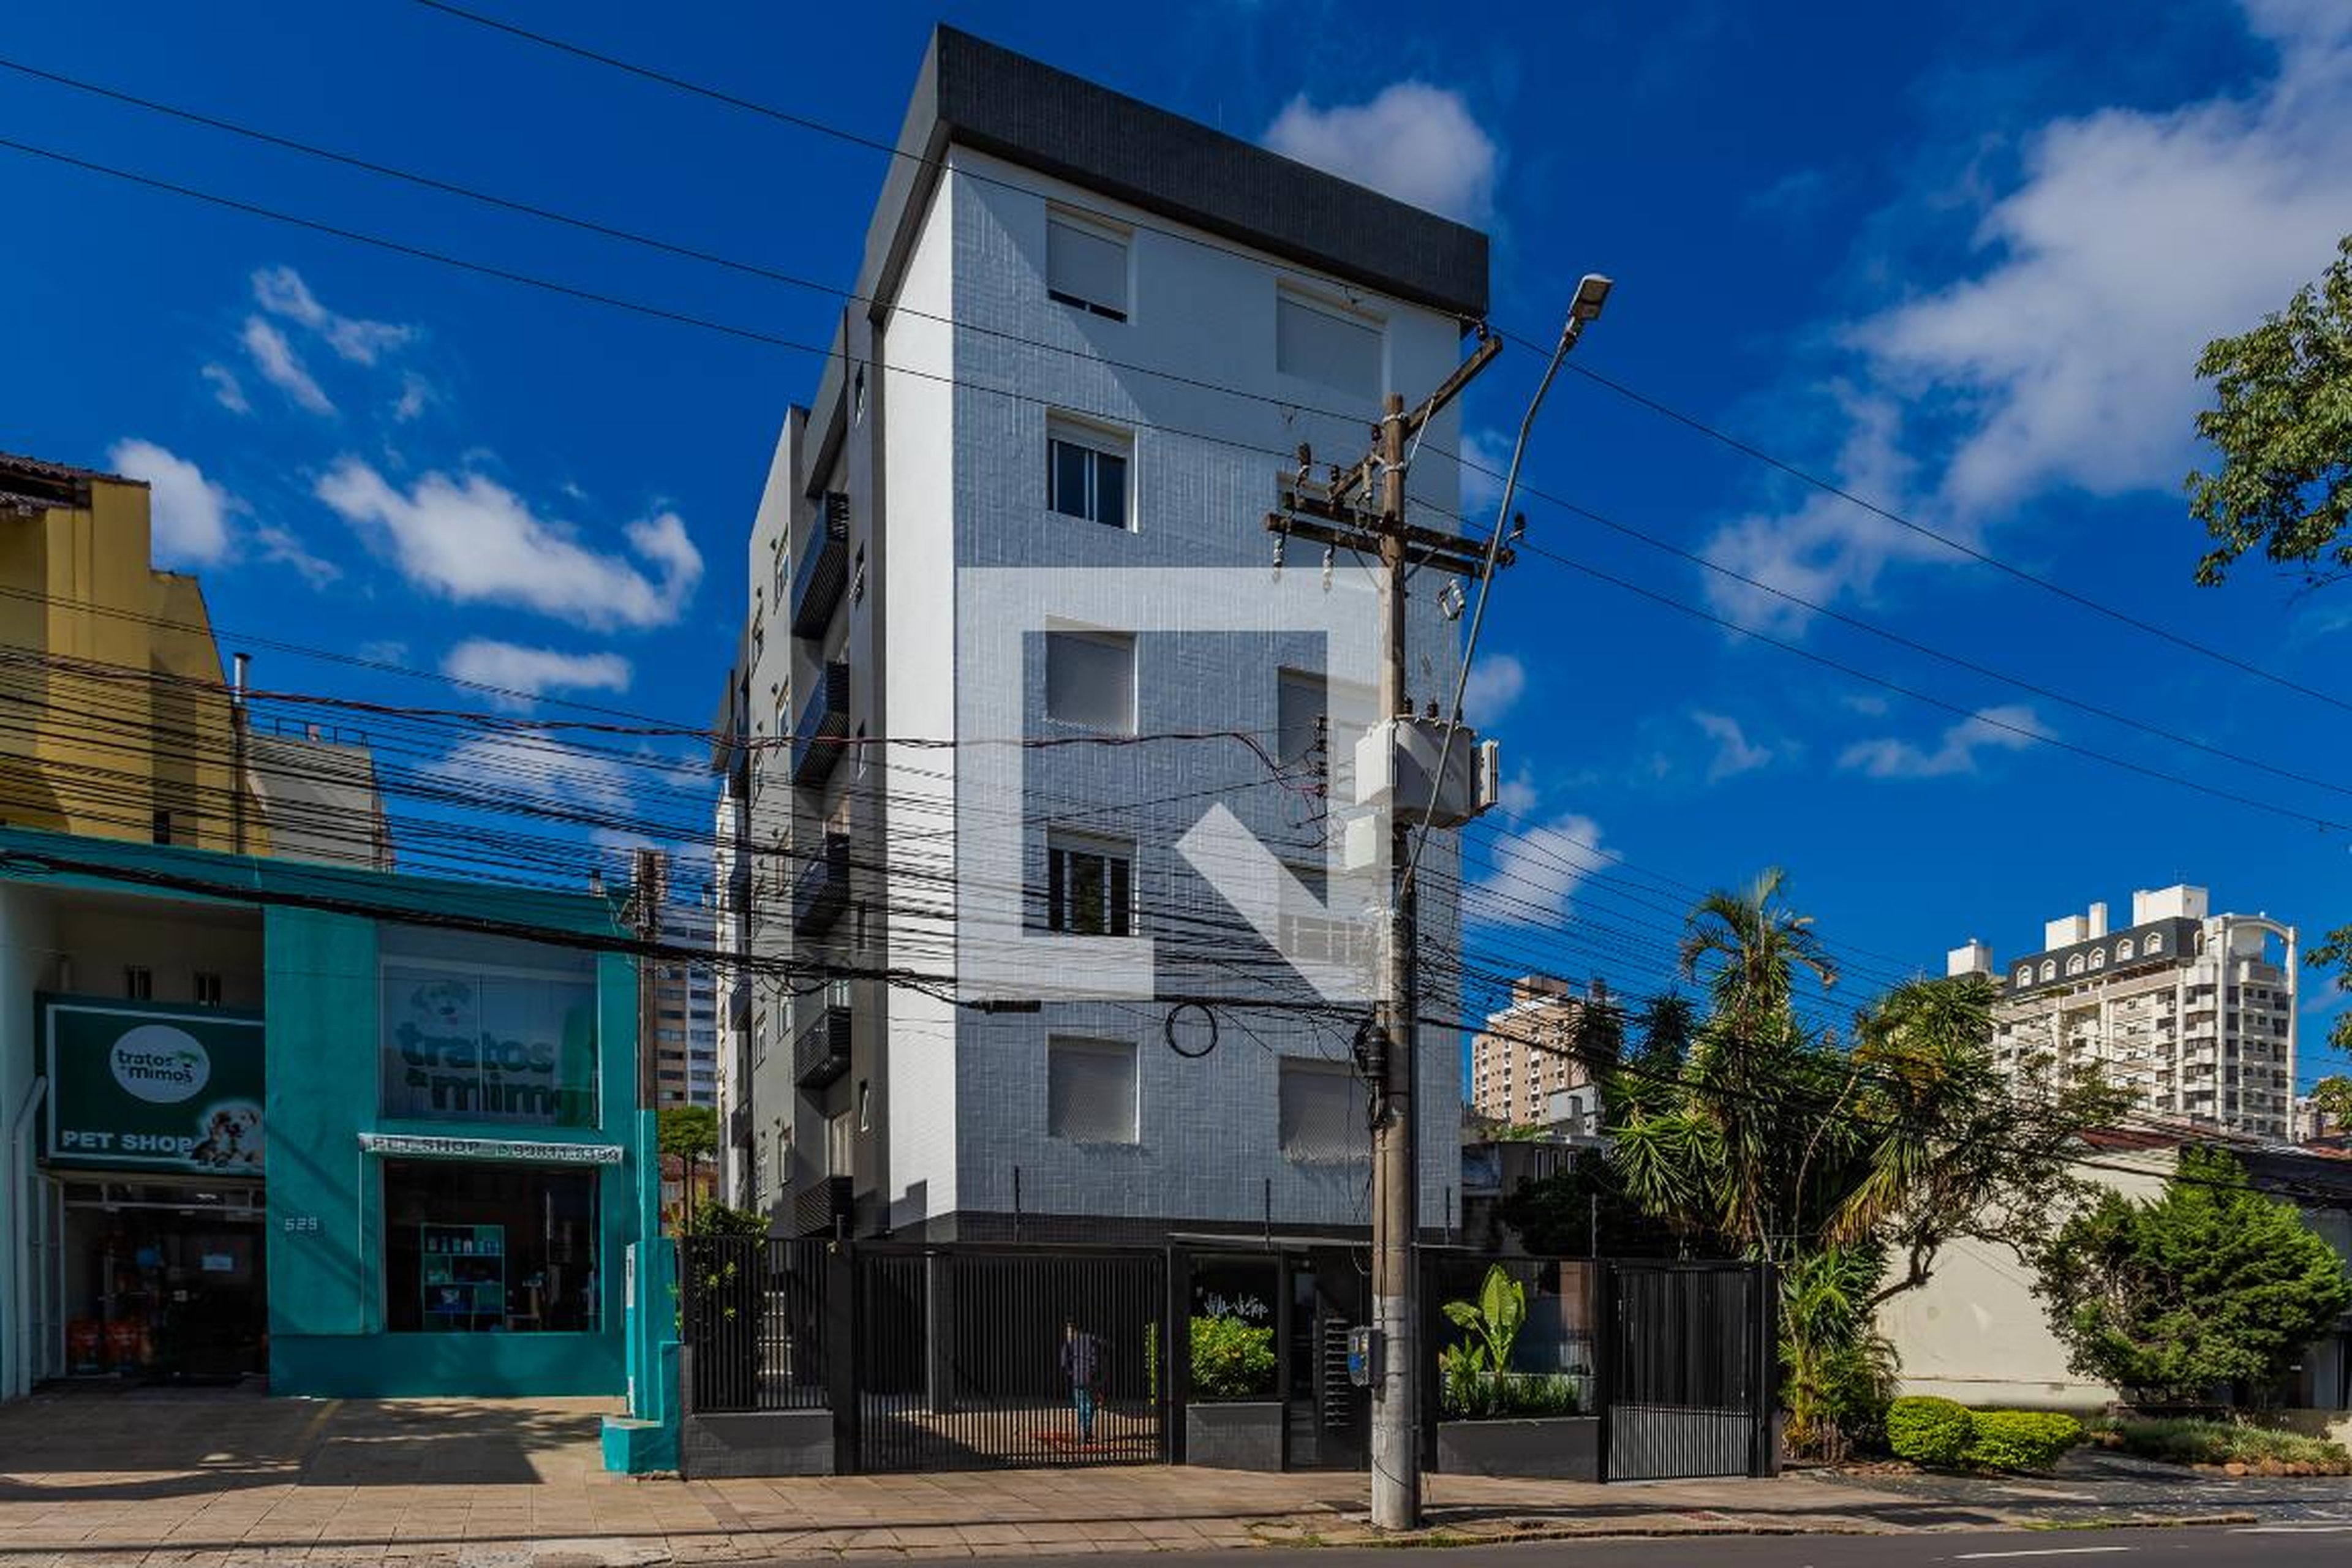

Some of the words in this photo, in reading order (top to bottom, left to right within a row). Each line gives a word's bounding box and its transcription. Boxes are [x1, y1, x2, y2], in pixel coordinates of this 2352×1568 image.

[117, 1049, 175, 1066] tratos
[396, 1022, 553, 1073] tratos
[129, 1067, 193, 1083] mimos
[432, 1072, 559, 1114] mim
[61, 1129, 115, 1149] PET
[121, 1133, 194, 1154] SHOP
[422, 1139, 479, 1152] SHOP
